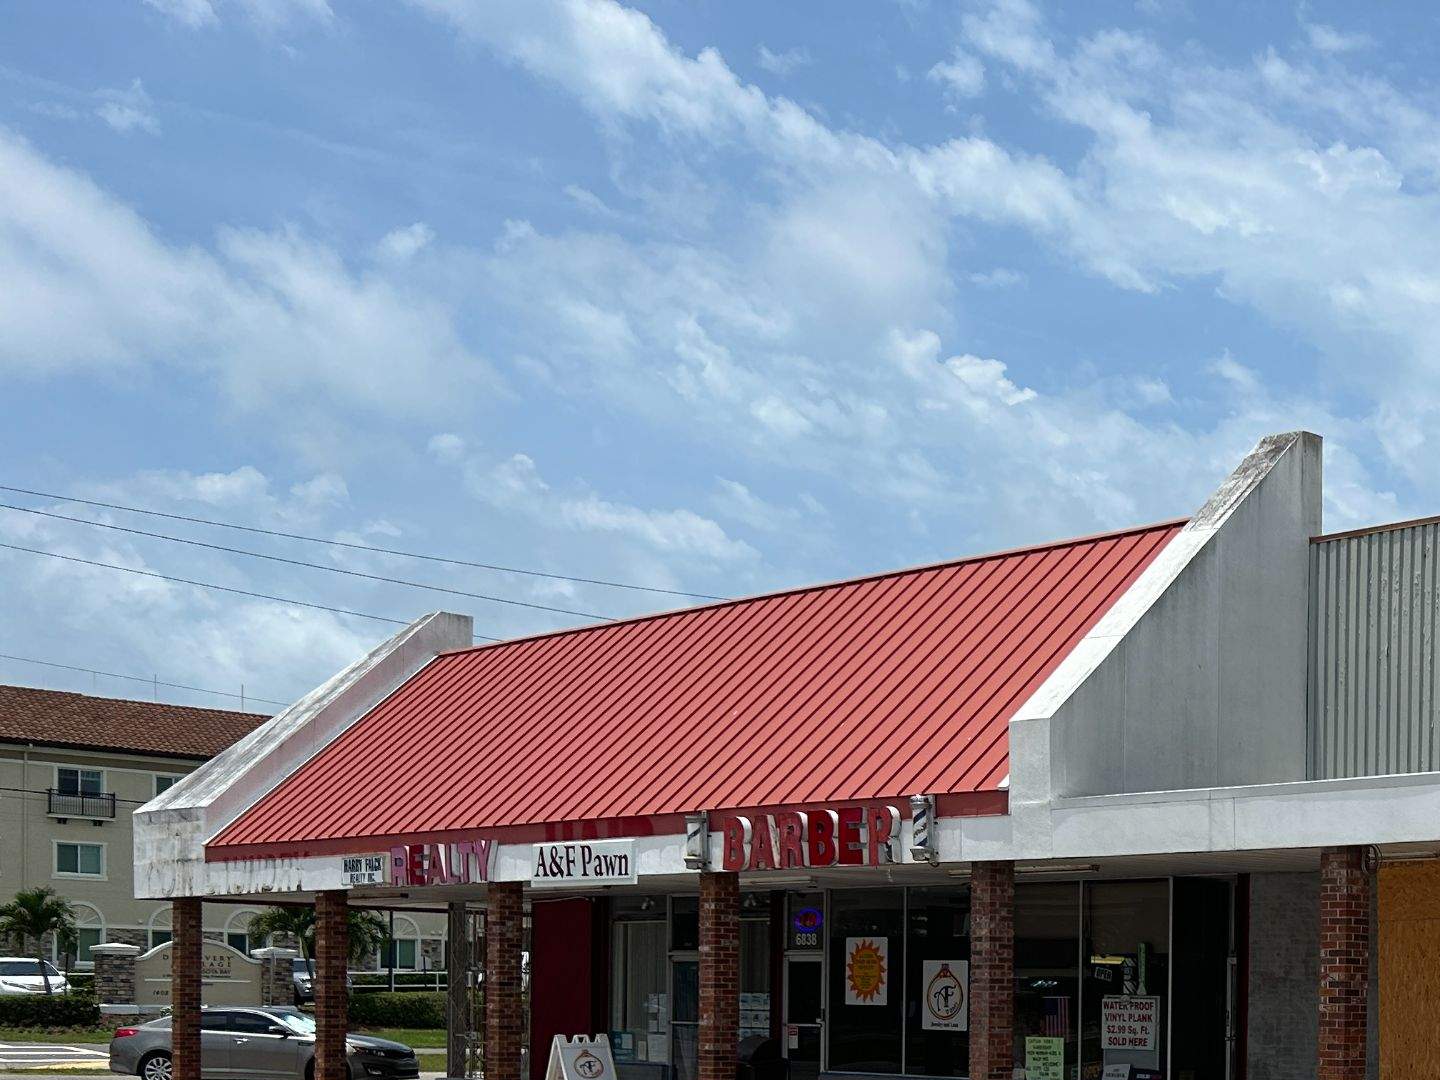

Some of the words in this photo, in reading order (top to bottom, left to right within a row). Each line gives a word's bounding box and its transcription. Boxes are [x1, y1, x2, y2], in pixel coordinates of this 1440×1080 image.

[722, 805, 902, 872] BARBER
[390, 839, 493, 887] REALTY
[534, 845, 576, 878] A&F
[580, 845, 629, 877] Pawn
[796, 933, 817, 946] 6838
[1104, 1012, 1126, 1022] VINYL
[1128, 1013, 1153, 1023] PLANK
[1107, 1025, 1126, 1034] $2.99
[1108, 1037, 1127, 1046] SOLD
[1129, 1037, 1148, 1047] HERE
